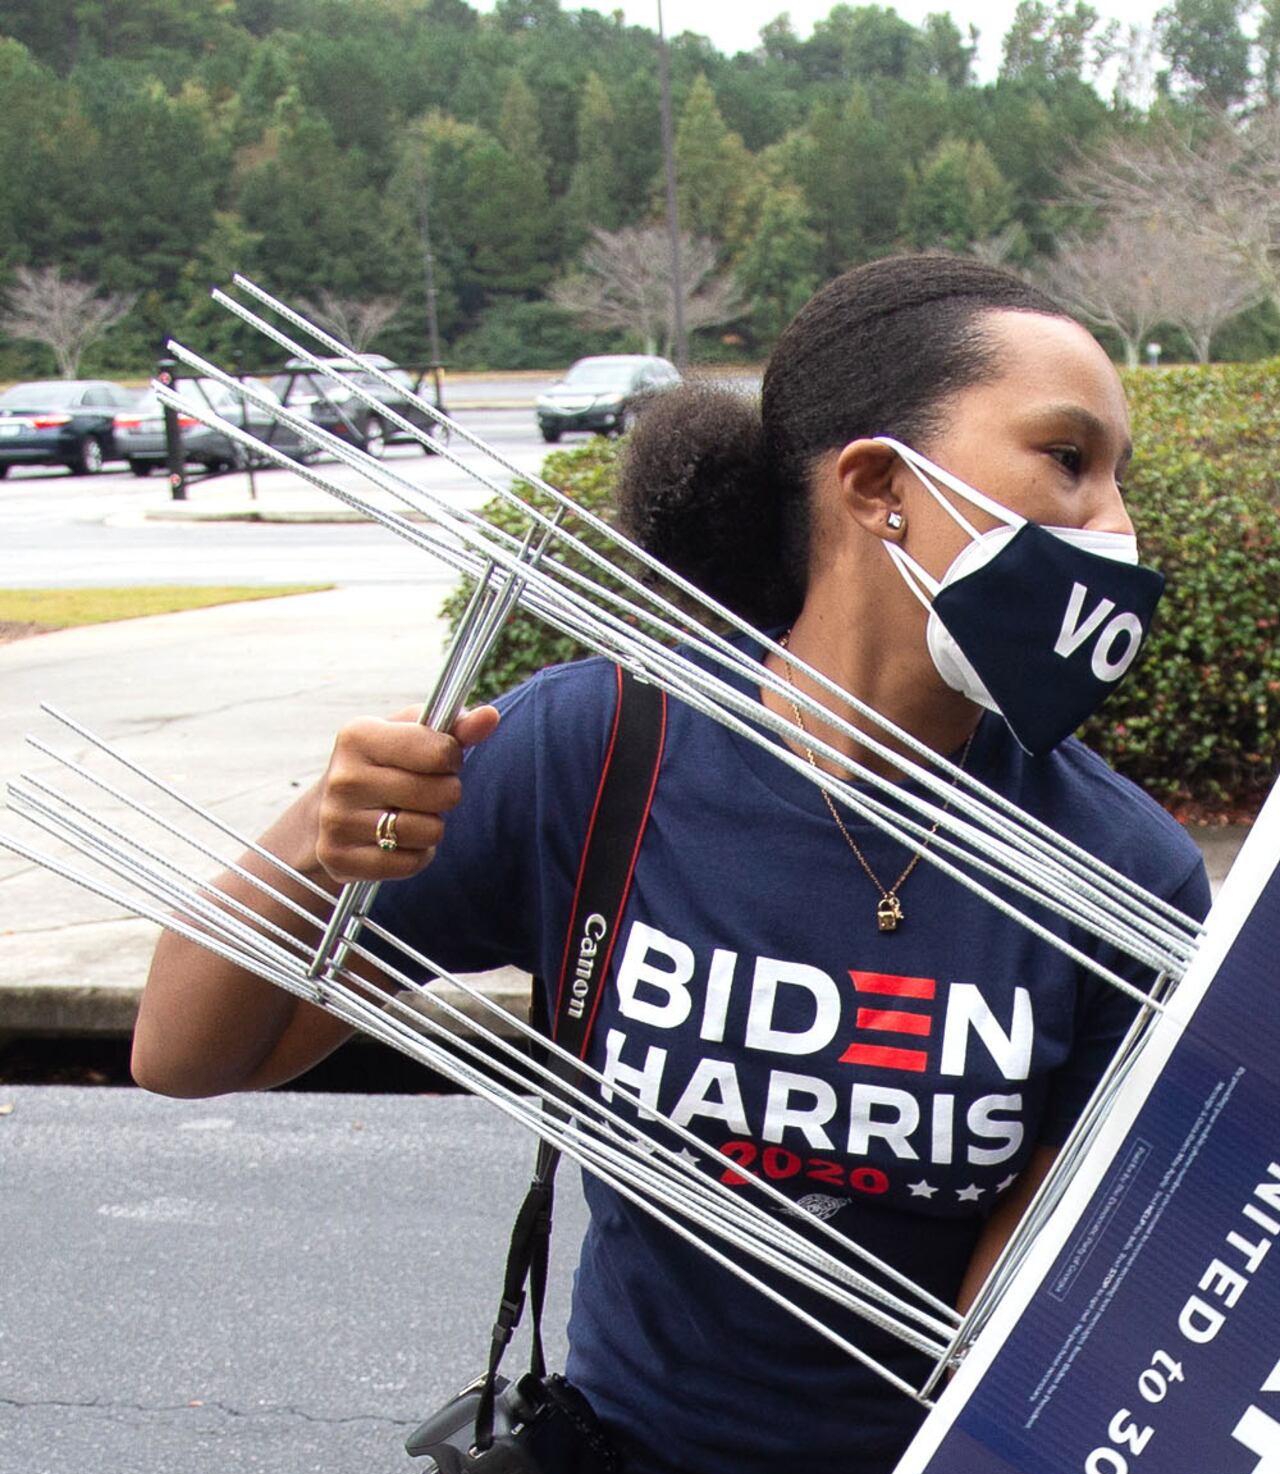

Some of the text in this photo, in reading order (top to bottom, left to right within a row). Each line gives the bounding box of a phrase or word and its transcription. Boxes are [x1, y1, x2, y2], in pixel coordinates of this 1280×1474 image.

[1054, 582, 1142, 681] VO
[568, 914, 606, 1018] Canon
[617, 921, 1033, 1080] BIDEN
[601, 1028, 1024, 1166] HARRIS
[718, 1140, 889, 1195] 2020
[1138, 1350, 1184, 1403] to
